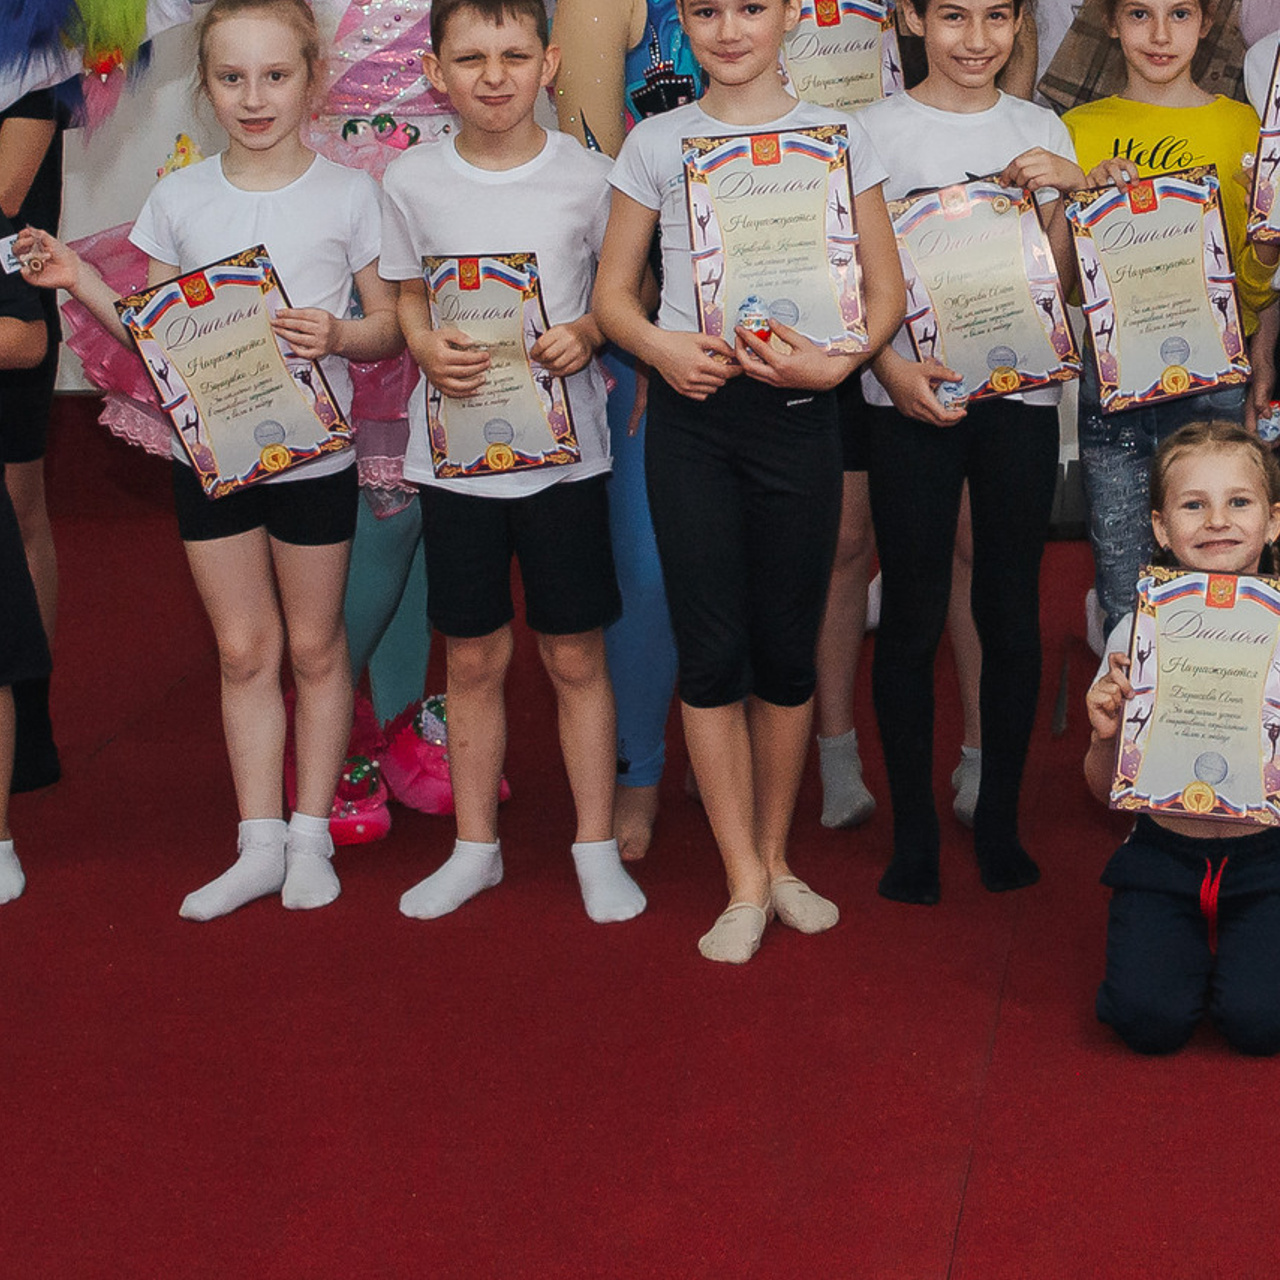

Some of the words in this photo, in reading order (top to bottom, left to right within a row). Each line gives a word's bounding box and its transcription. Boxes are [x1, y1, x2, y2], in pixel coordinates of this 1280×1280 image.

[788, 32, 878, 64] Диплом
[1109, 135, 1205, 170] Hello
[715, 171, 823, 204] Диплом
[1100, 220, 1198, 255] Диплом
[165, 301, 262, 353] Диплом
[441, 295, 518, 324] Диплом
[1160, 609, 1271, 645] Диплом
